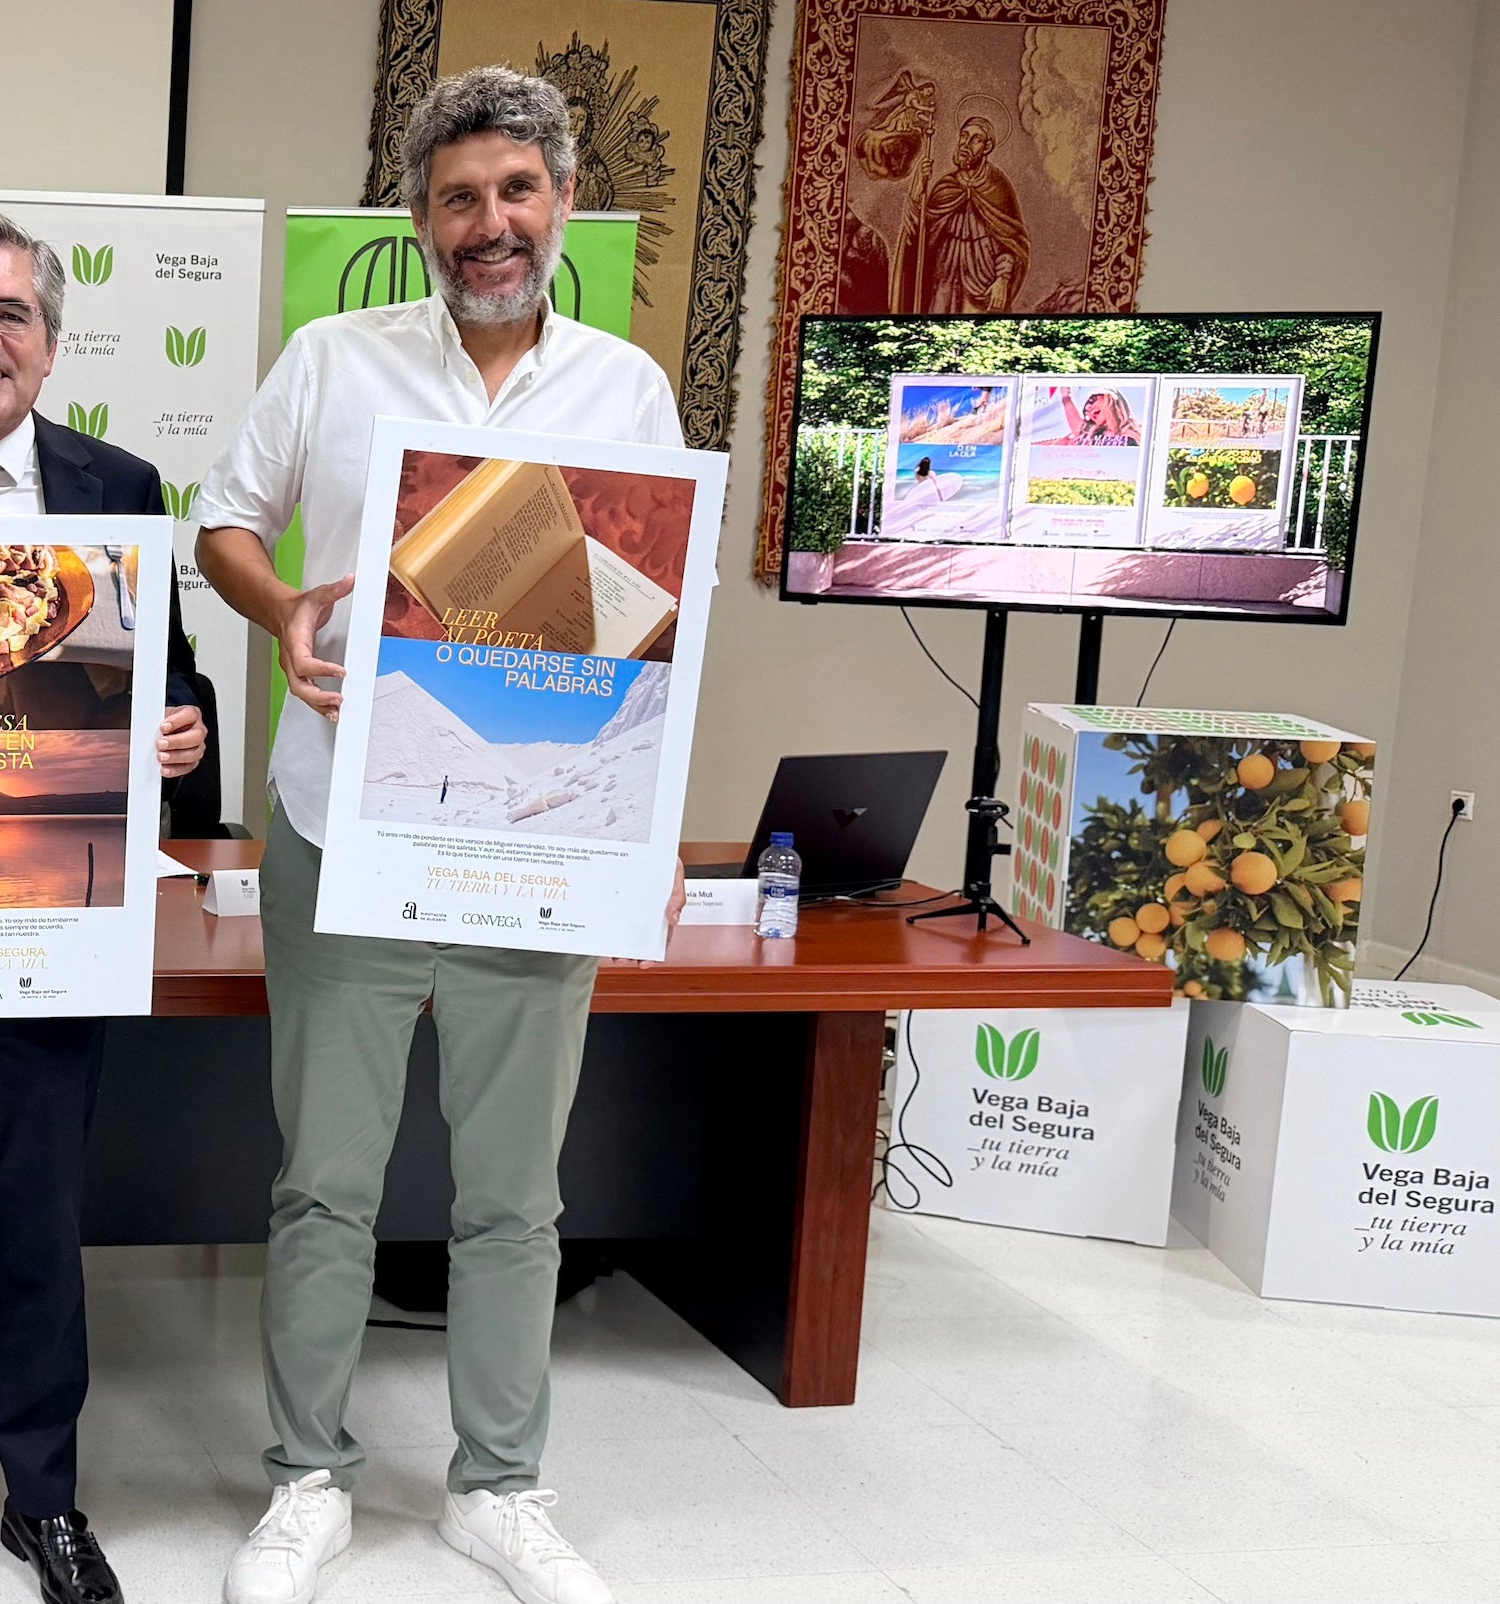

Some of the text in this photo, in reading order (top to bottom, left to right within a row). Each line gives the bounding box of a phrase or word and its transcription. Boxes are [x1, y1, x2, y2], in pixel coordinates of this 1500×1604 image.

[156, 254, 218, 268] Vega Baja
[156, 268, 222, 282] del Segura
[84, 331, 120, 342] tierra
[63, 344, 114, 356] y la mía
[178, 412, 213, 423] tierra
[156, 424, 208, 437] y la mía
[441, 608, 498, 630] LEER
[439, 627, 544, 652] AL POETA
[436, 644, 616, 678] O QUEDARSE SIN
[504, 671, 613, 697] PALABRAS
[6, 734, 36, 751] EN
[426, 878, 446, 890] TU
[448, 879, 498, 895] TIERRA
[502, 884, 510, 896] Y
[516, 886, 534, 898] LA
[427, 867, 570, 888] VEGA BAJA DEL SEGURA.
[462, 912, 522, 928] CONVEGA
[972, 1088, 1090, 1120] Vega Baja
[969, 1110, 1094, 1140] del Segura
[1198, 1100, 1240, 1146] Vega Baja
[1008, 1140, 1069, 1160] tierra
[1195, 1123, 1240, 1170] del Segura
[970, 1155, 1059, 1178] y la mía
[1362, 1162, 1490, 1192] Vega Baja
[1358, 1188, 1495, 1214] del Segura
[1400, 1216, 1468, 1236] tierra
[1358, 1234, 1455, 1255] y la mía
